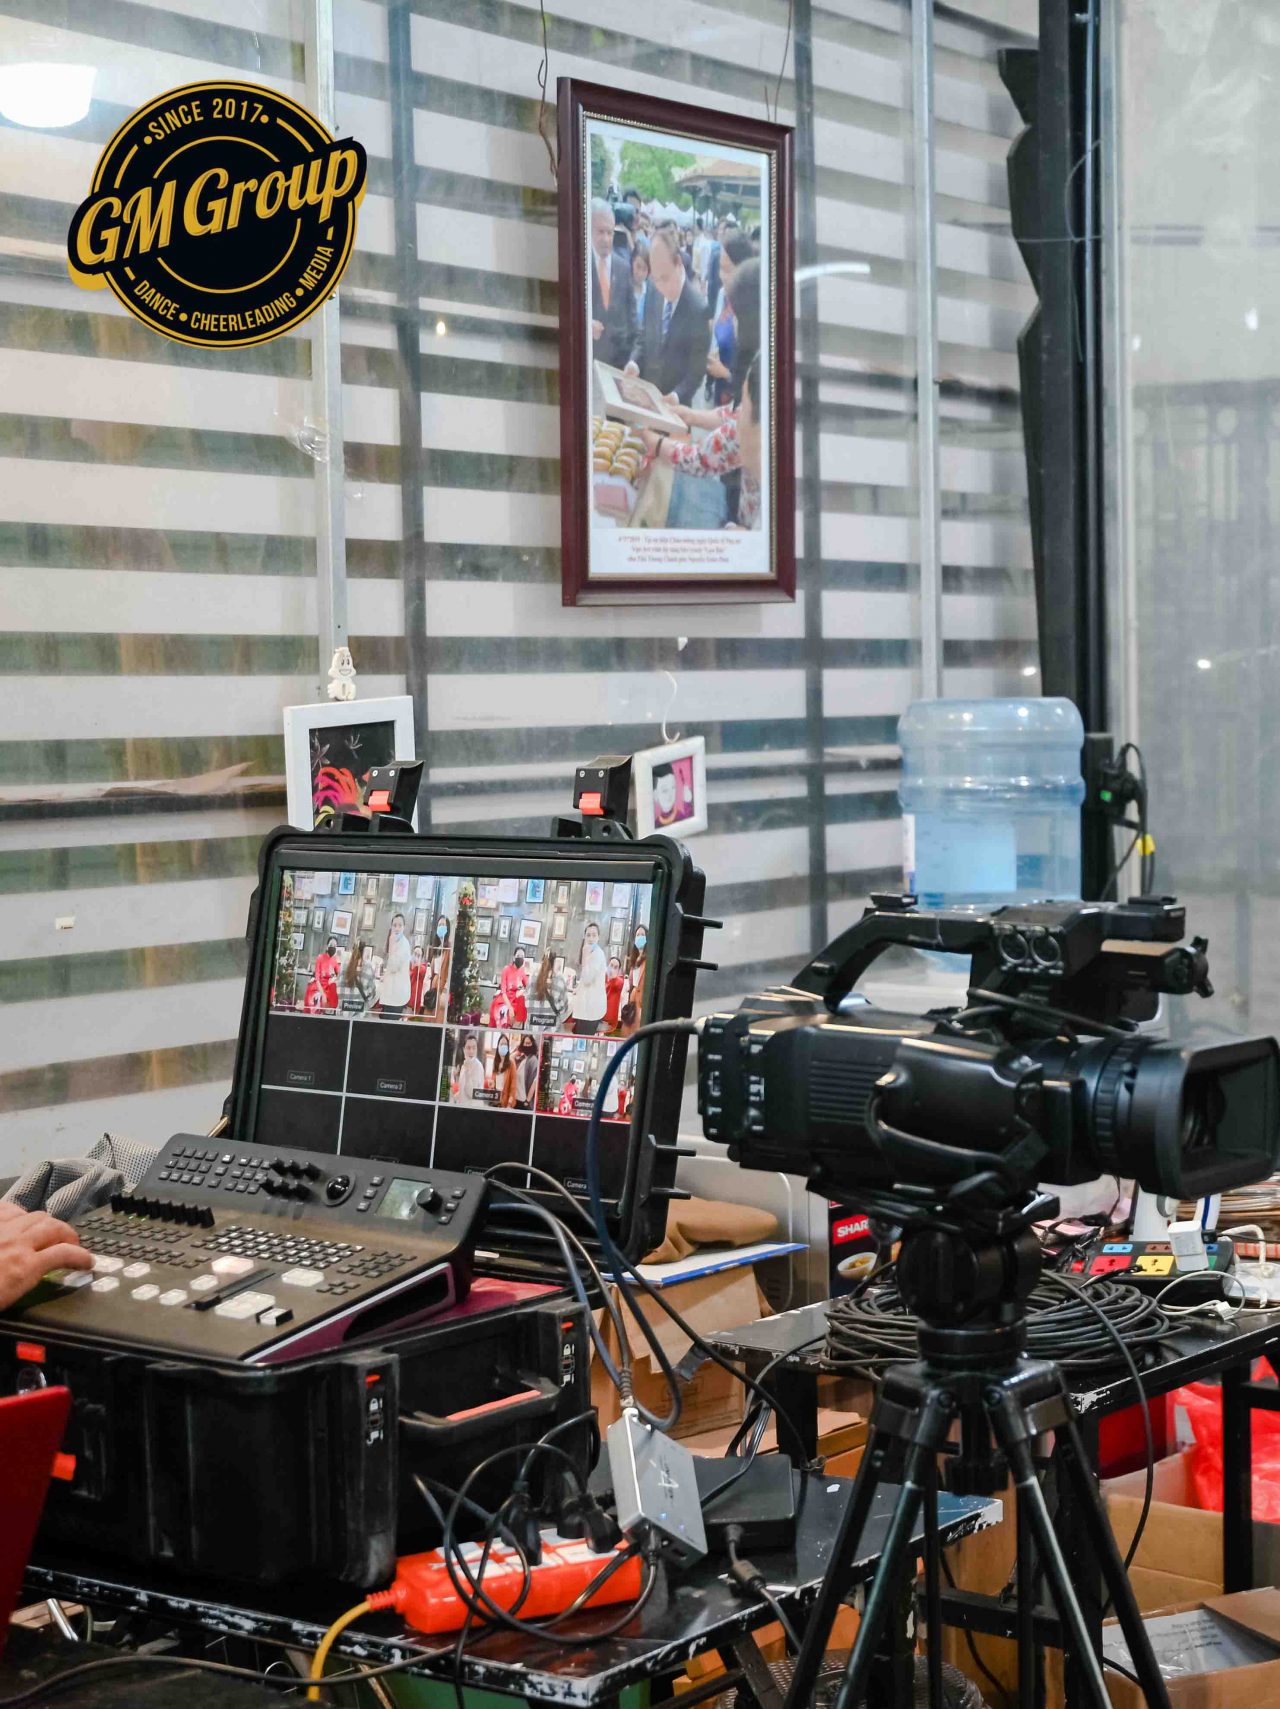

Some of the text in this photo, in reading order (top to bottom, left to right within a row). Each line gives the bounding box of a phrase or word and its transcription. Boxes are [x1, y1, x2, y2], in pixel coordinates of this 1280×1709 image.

[532, 1016, 555, 1025] Program
[289, 1073, 307, 1081] Camera
[379, 1082, 397, 1090] Camera
[474, 1091, 493, 1099] Camera
[566, 1180, 587, 1189] Camera
[837, 1218, 870, 1238] SHAR
